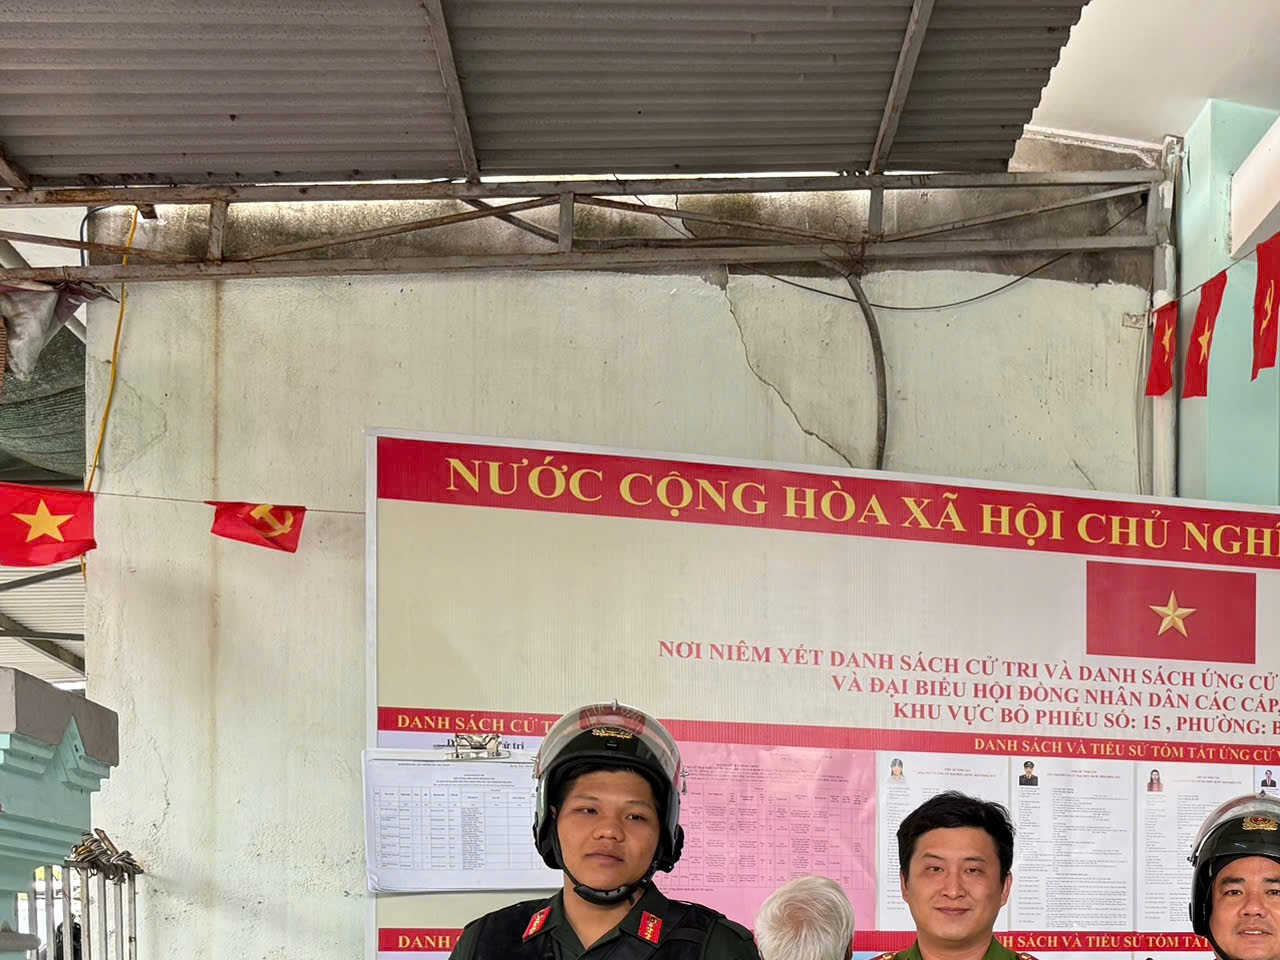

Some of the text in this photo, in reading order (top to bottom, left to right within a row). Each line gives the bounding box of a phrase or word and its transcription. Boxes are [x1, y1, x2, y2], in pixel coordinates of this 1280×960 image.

[445, 456, 602, 502] NƯỚC
[619, 471, 768, 517] CỘNG
[782, 480, 890, 526] HÒA
[900, 493, 967, 533] XÃ
[979, 503, 1065, 546] HỘI
[1077, 509, 1171, 549] CHỦ
[658, 640, 702, 660] NƠI
[709, 640, 771, 663] NIÊM
[777, 644, 824, 667] YẾT
[830, 651, 895, 670] DANH
[900, 651, 959, 674] SÁCH
[965, 655, 998, 676] CỬ
[1002, 661, 1038, 679] TRI
[1044, 660, 1073, 682] VÀ
[1079, 666, 1136, 685] DANH
[1142, 664, 1195, 687] SÁCH
[1202, 665, 1244, 690] ỨNG
[1249, 671, 1279, 692] CỬ
[832, 671, 862, 692] VÀ
[869, 677, 909, 698] ĐẠI
[915, 676, 966, 698] BIỂU
[973, 682, 1012, 704] HỘI
[1018, 681, 1079, 705] ĐỒNG
[1084, 686, 1142, 707] NHÂN
[1148, 689, 1190, 708] DÂN
[1195, 688, 1236, 710] CÁC
[398, 714, 450, 730] DANH
[455, 713, 504, 732] SÁCH
[510, 716, 539, 733] CỬ
[893, 703, 941, 720] KHU
[948, 703, 994, 726] VỰC
[1001, 703, 1030, 724] BỎ
[1035, 706, 1099, 728] PHIẾU
[1104, 709, 1136, 729] SỐ:
[1143, 714, 1161, 730] 15
[1176, 714, 1266, 736] PHƯỜNG:
[513, 741, 524, 750] tri
[974, 737, 1018, 752] DANH
[1022, 737, 1062, 753] SÁCH
[1067, 739, 1088, 755] VÀ
[1090, 739, 1124, 756] TIỂU
[1128, 742, 1149, 757] SỬ
[1151, 743, 1184, 759] TÓM
[1219, 745, 1250, 761] ỨNG
[1253, 747, 1275, 762] CỬ
[398, 935, 450, 948] DANH
[1017, 932, 1058, 948] SÁCH
[1062, 934, 1083, 948] VÀ
[1086, 933, 1119, 948] TIỂU
[1124, 934, 1144, 948] SỬ
[1147, 933, 1179, 948] TÓM
